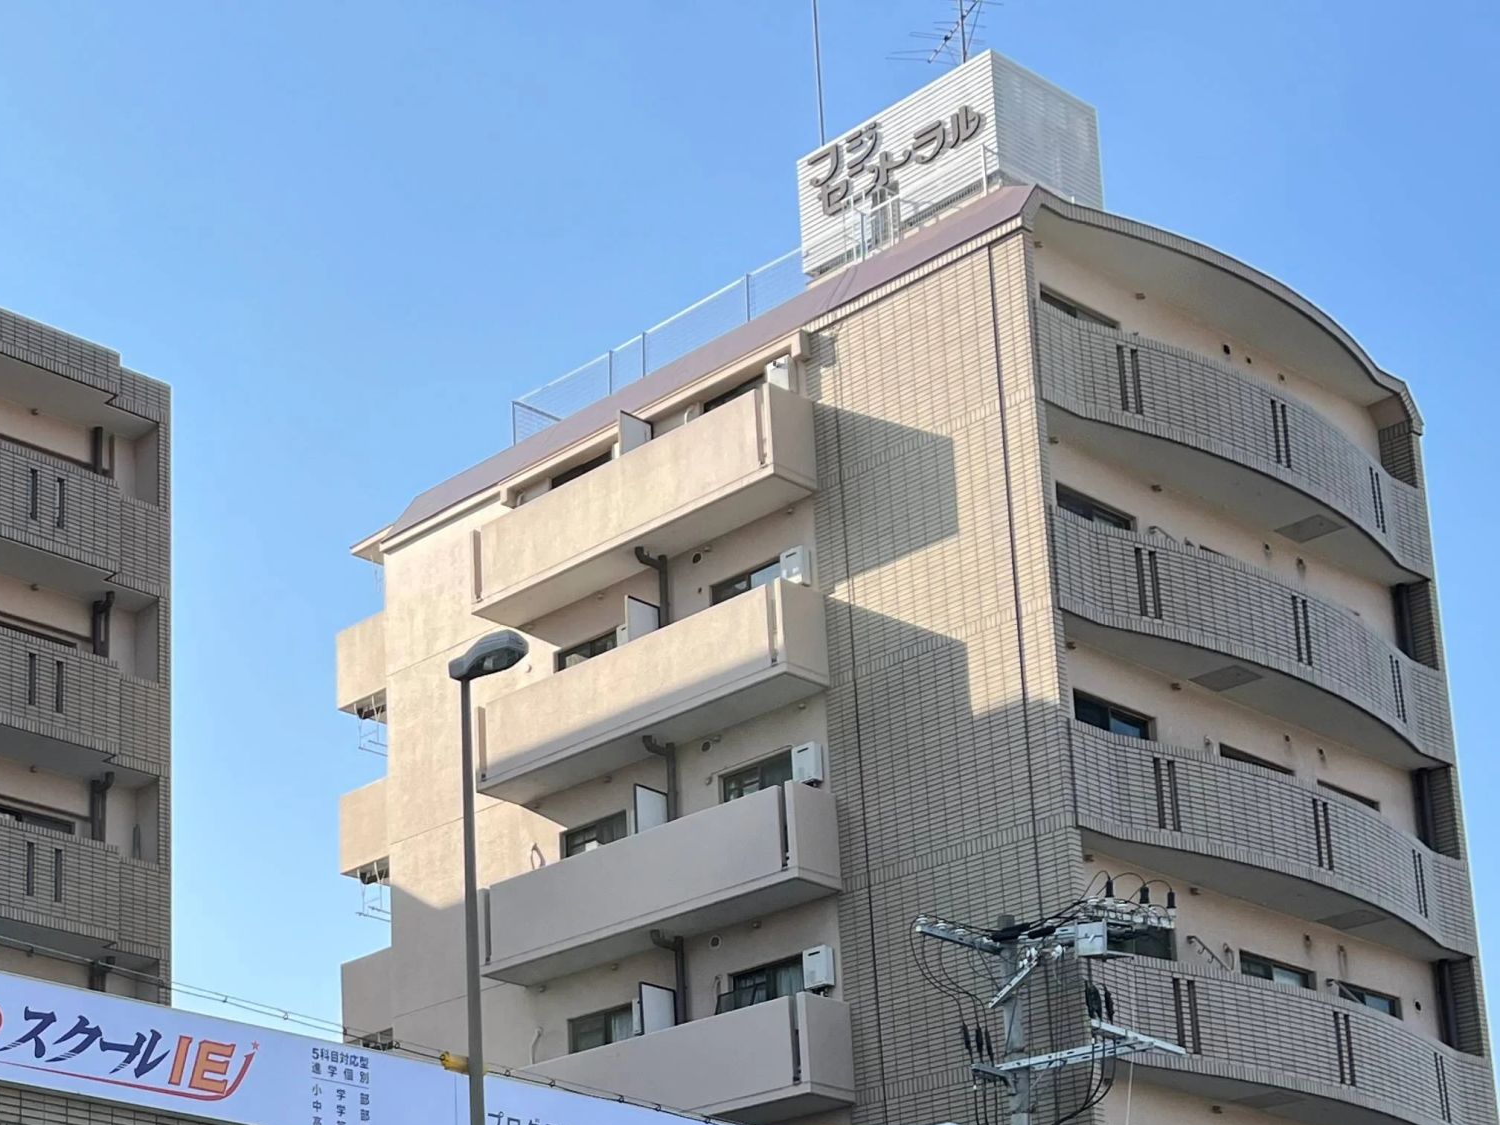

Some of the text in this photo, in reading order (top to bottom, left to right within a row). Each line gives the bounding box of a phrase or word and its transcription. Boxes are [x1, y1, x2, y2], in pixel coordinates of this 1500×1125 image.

[808, 122, 878, 186] フジ
[312, 1047, 369, 1070] 5科目対応型
[311, 1062, 370, 1085] 進学個別
[312, 1083, 370, 1106] 小学部
[312, 1100, 370, 1122] 中学部
